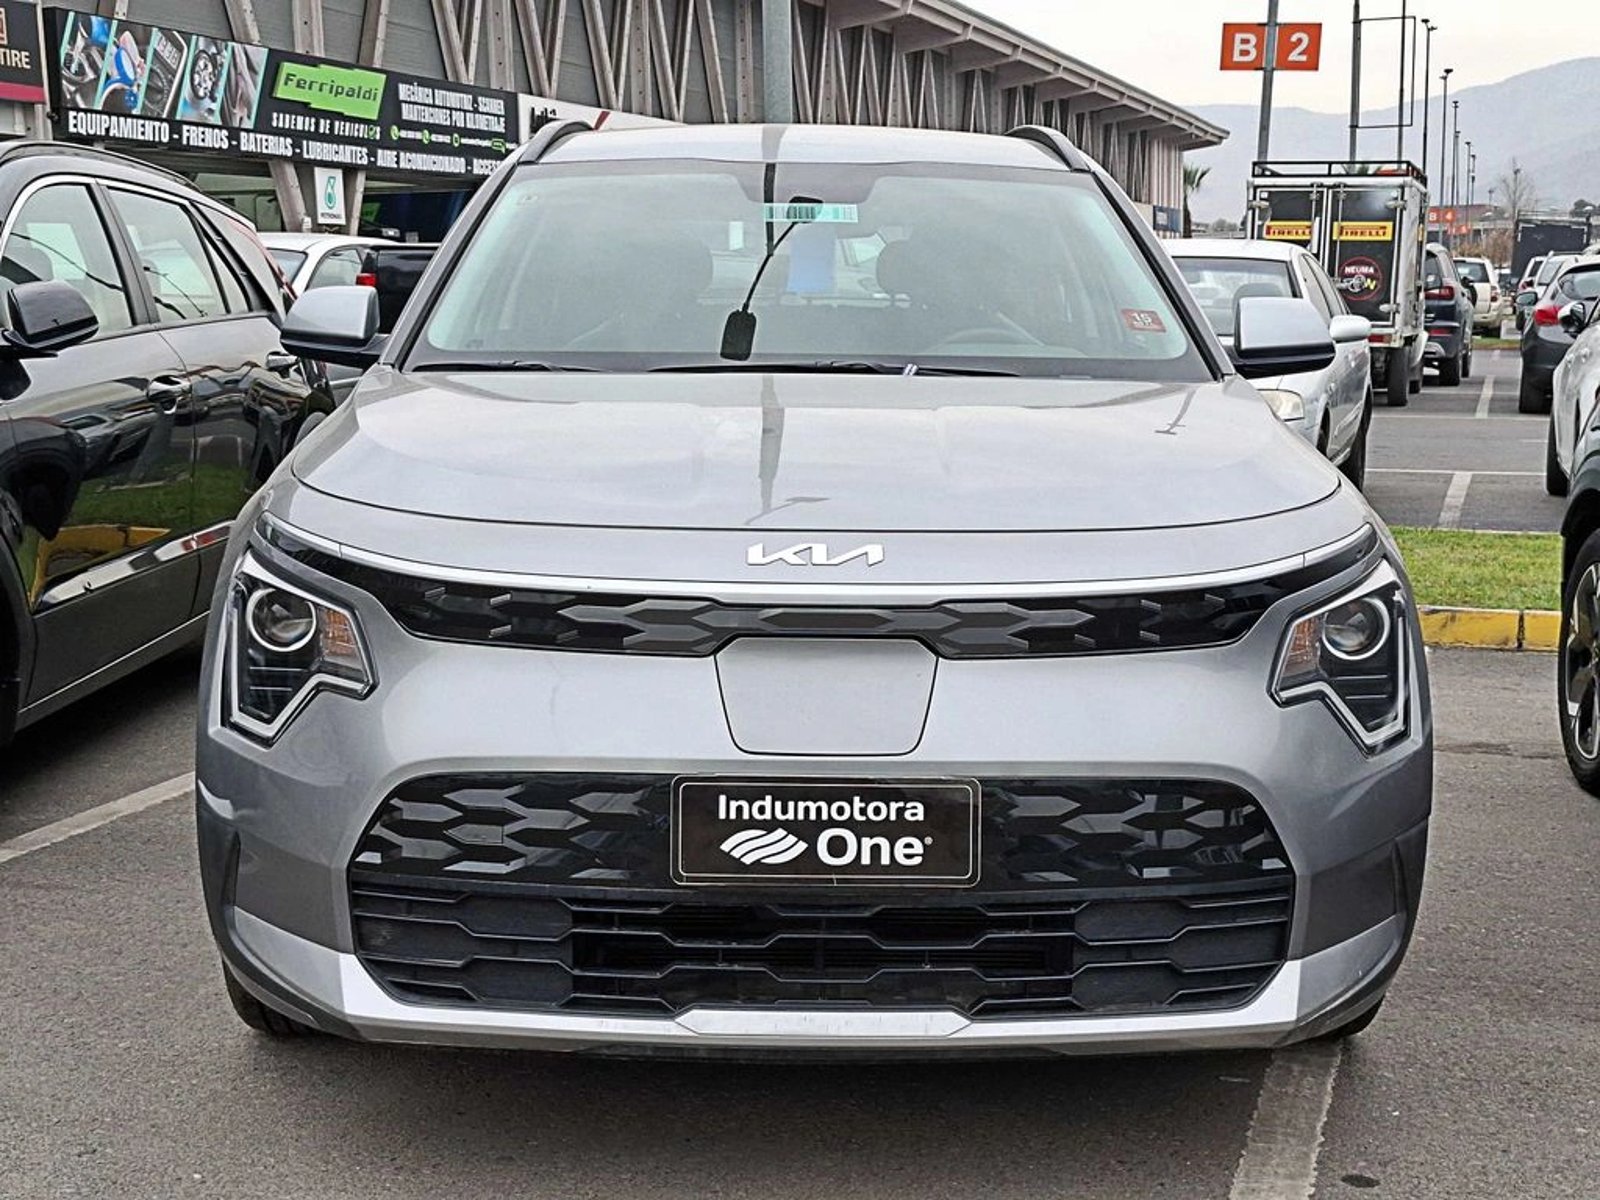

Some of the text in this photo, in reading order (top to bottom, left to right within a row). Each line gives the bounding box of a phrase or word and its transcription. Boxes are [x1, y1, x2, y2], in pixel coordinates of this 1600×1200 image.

[1232, 32, 1309, 62] B 2
[283, 73, 378, 102] Ferripaldi
[272, 112, 316, 132] SABEMOS
[319, 119, 331, 134] DE
[451, 110, 465, 128] POR
[68, 110, 169, 142] EQUIPAMIENTO
[182, 125, 229, 149] FRENOS
[240, 131, 293, 157] BATERIAS
[302, 140, 368, 165] LUBRICANTES
[377, 148, 398, 168] AIRE
[399, 151, 466, 173] ACONDICIONADO
[747, 543, 884, 567] KIA
[718, 794, 925, 822] Indumotora
